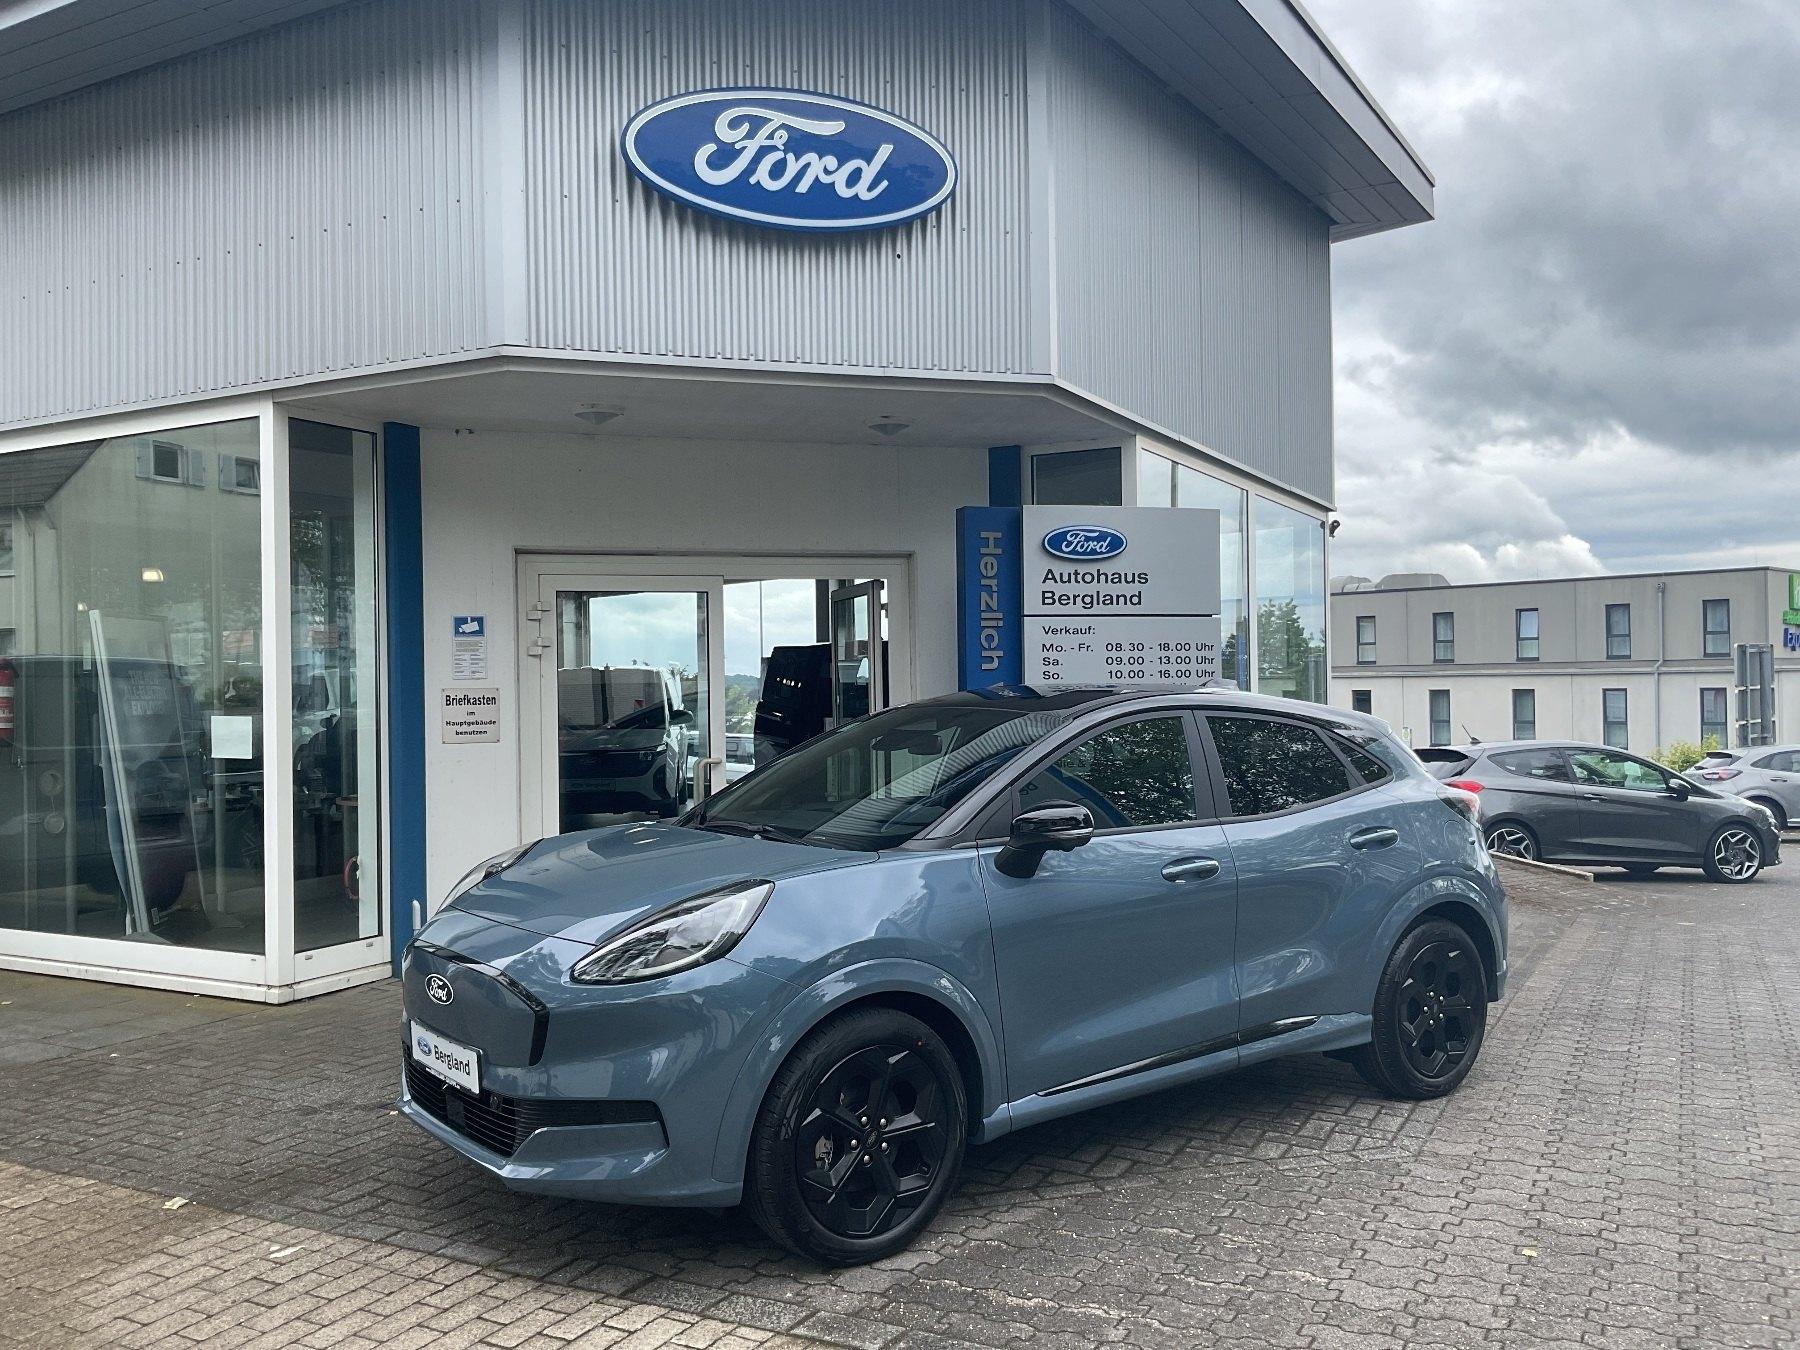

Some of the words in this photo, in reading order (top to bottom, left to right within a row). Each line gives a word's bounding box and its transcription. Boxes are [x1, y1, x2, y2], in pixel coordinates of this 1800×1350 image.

[694, 107, 894, 201] Ford
[1061, 531, 1111, 554] Ford
[1041, 568, 1149, 585] Autohaus
[979, 531, 1004, 671] Herzlich
[1041, 590, 1142, 610] Bergland
[1041, 625, 1096, 636] Verkauf:
[1041, 642, 1067, 653] Mo.
[1078, 642, 1094, 653] Fr.
[1105, 642, 1145, 653] 08.30
[1157, 642, 1192, 653] 18.00
[1195, 642, 1215, 653] Uhr
[1042, 656, 1064, 667] Sa.
[1105, 656, 1145, 667] 09.00
[1157, 656, 1192, 667] 13.00
[1195, 656, 1216, 667] Uhr
[1042, 669, 1064, 681] So.
[1107, 669, 1145, 681] 10.00
[1157, 669, 1192, 681] 16.00
[1195, 669, 1216, 681] Uhr
[445, 694, 497, 707] Briefkasten
[445, 719, 497, 728] Hauptgebäude
[430, 977, 448, 1001] Ford
[433, 1044, 471, 1077] Bergland
